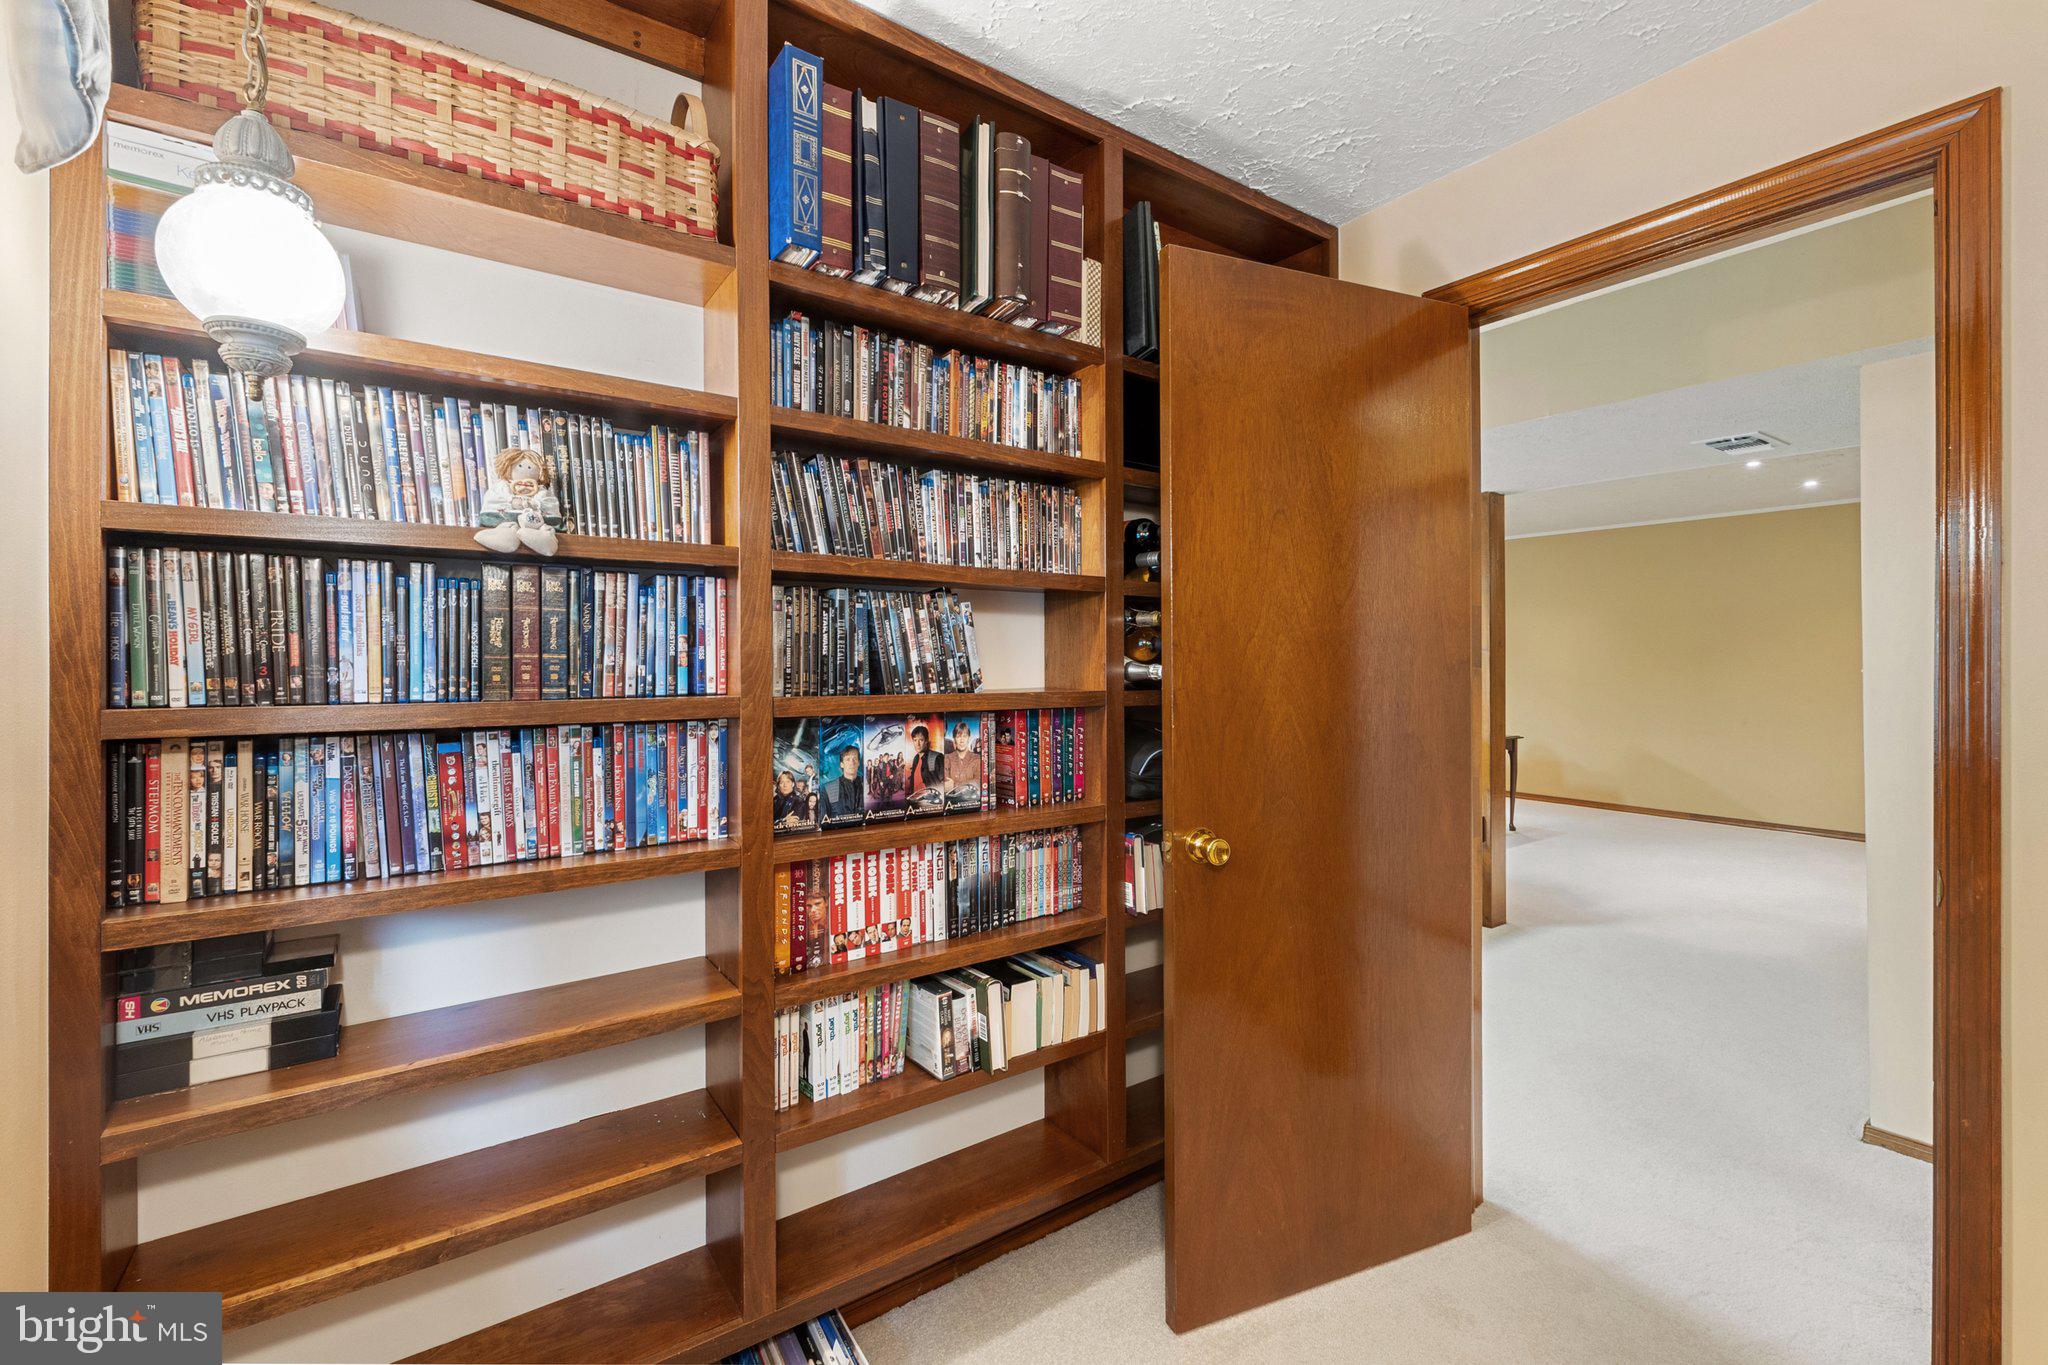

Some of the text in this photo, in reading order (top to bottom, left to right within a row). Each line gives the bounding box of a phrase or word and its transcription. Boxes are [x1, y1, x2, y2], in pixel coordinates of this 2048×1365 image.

[113, 141, 166, 159] memorex
[185, 402, 198, 437] APOLLO
[344, 426, 354, 446] DUNE
[253, 438, 267, 461] bella
[659, 435, 668, 483] INCEPTION
[111, 611, 123, 627] Life
[132, 603, 142, 623] LITTLE
[187, 607, 200, 646] MY GIRL
[341, 594, 352, 641] soul surfer
[583, 602, 592, 633] NARNIA
[168, 600, 179, 667] BEAN'S HOLIDAY
[203, 610, 214, 670] TREASURE
[271, 609, 286, 653] PRIDE
[397, 634, 406, 667] BIBLE
[838, 639, 846, 665] RECALL
[327, 743, 336, 761] Walk
[173, 781, 184, 797] TEN
[343, 765, 353, 793] DANCE
[427, 775, 439, 808] CHRIST'S
[504, 767, 512, 786] BELLS
[549, 779, 558, 805] FAMILY
[606, 771, 614, 807] CHRISTMAS
[148, 780, 160, 834] STEPMOM
[211, 791, 219, 845] TRISTAN ISOLDE
[241, 793, 250, 833] WAR HORSE
[297, 791, 305, 818] ULTIMATE
[505, 803, 515, 828] MARY'S
[551, 806, 559, 825] MAN
[584, 776, 594, 829] Trading Christmas
[866, 809, 907, 820] Andromeda
[907, 804, 946, 815] Andromeda
[946, 800, 982, 811] Andromeda
[173, 797, 184, 867] COMMANDMENTS
[226, 808, 234, 849] UNBROKEN
[254, 802, 263, 850] WAR ROOM
[296, 818, 308, 827] 5
[822, 814, 865, 825] Andromeda
[329, 823, 337, 853] POUNDS
[852, 858, 861, 902] MONK
[868, 854, 877, 897] MONK
[885, 852, 895, 895] MONK
[901, 849, 910, 892] MONK
[936, 847, 944, 881] NCIS
[834, 861, 845, 905] MONK
[796, 882, 806, 942] FRIENDS
[180, 974, 308, 1007] MEMOREX 120
[206, 996, 307, 1023] VHS PLAYPACK
[883, 997, 891, 1032] reba
[136, 1022, 161, 1035] VHS
[816, 1022, 824, 1048] psych
[829, 1016, 837, 1042] psych
